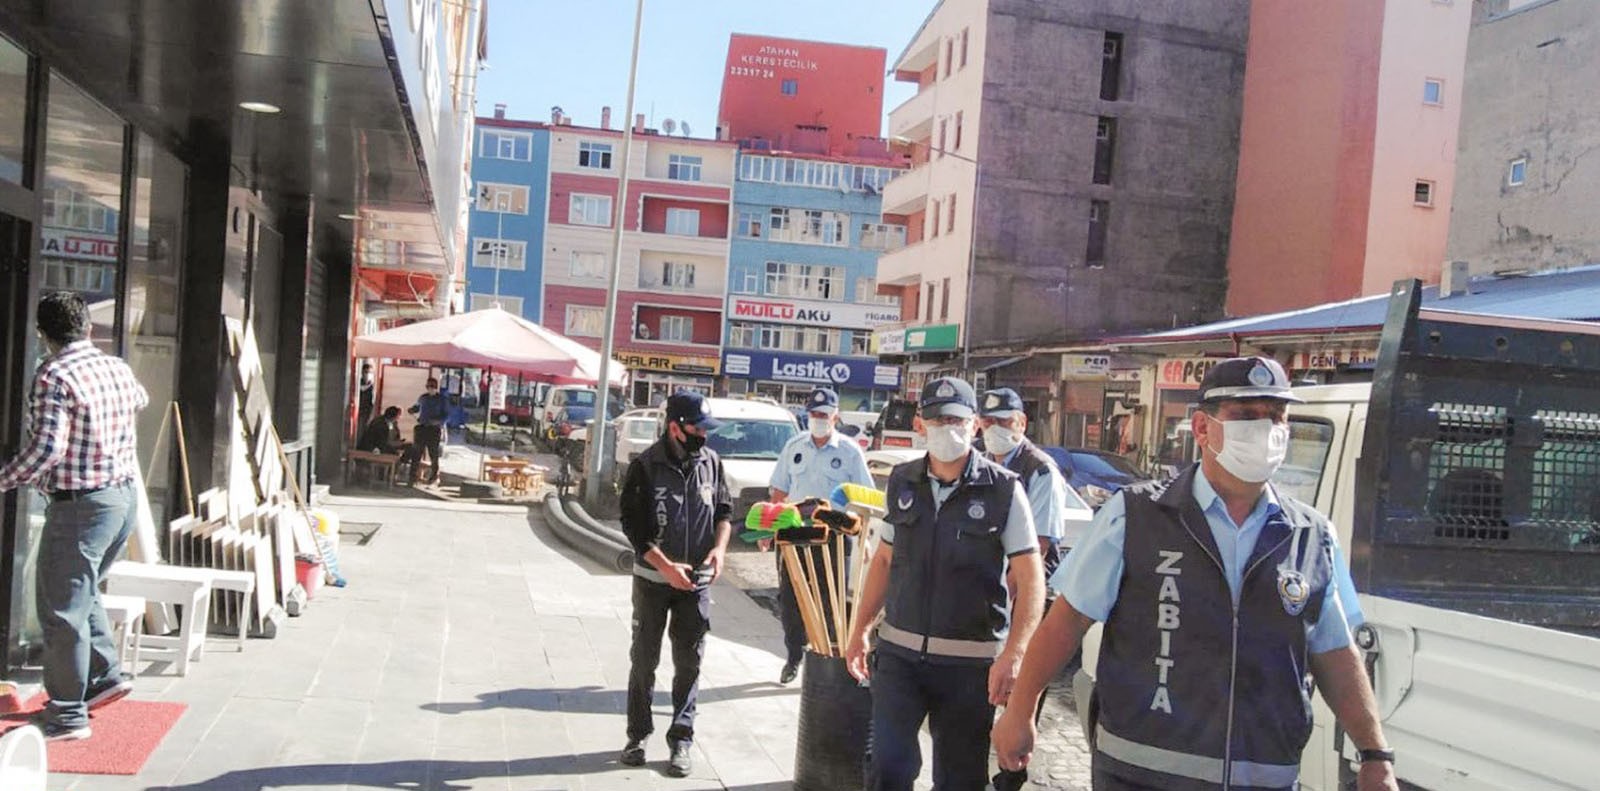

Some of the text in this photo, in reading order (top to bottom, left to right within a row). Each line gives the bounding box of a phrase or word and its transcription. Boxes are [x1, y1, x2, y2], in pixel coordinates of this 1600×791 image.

[759, 46, 799, 57] ATAHAN
[735, 299, 794, 319] MUTLU
[773, 358, 831, 379] Lastik
[1150, 550, 1184, 714] ZABITA
